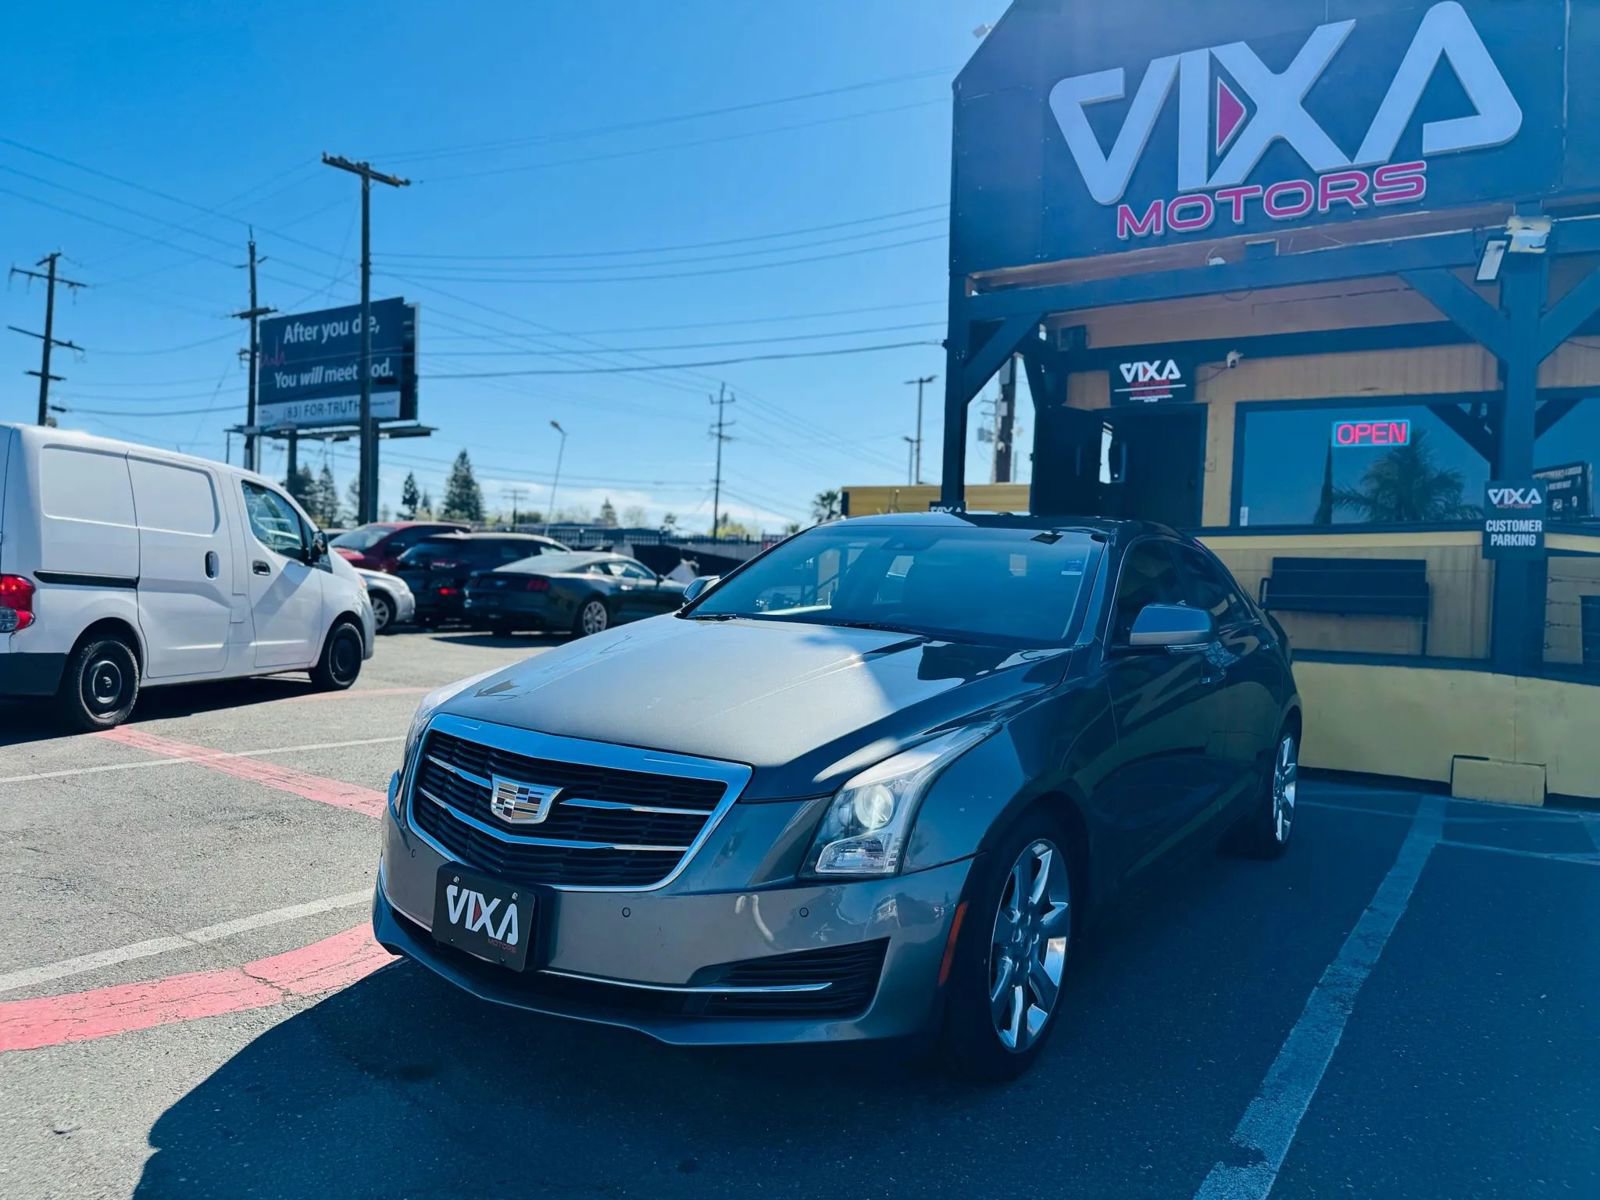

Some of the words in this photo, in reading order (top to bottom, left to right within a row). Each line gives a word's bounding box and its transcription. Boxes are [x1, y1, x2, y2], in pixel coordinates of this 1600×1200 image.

[1049, 0, 1523, 205] VIXA
[1116, 159, 1428, 240] MOTORS
[283, 321, 319, 345] After
[321, 319, 350, 345] you
[352, 312, 380, 335] de,
[274, 371, 298, 389] You
[300, 366, 324, 387] will
[324, 363, 358, 384] meet
[370, 357, 394, 378] od.
[1119, 359, 1181, 384] VIXA
[1337, 422, 1407, 445] OPEN
[1487, 487, 1543, 505] VIXA
[1485, 519, 1543, 532] CUSTOMER
[1490, 533, 1537, 547] PARKING
[446, 884, 519, 946] VIXA
